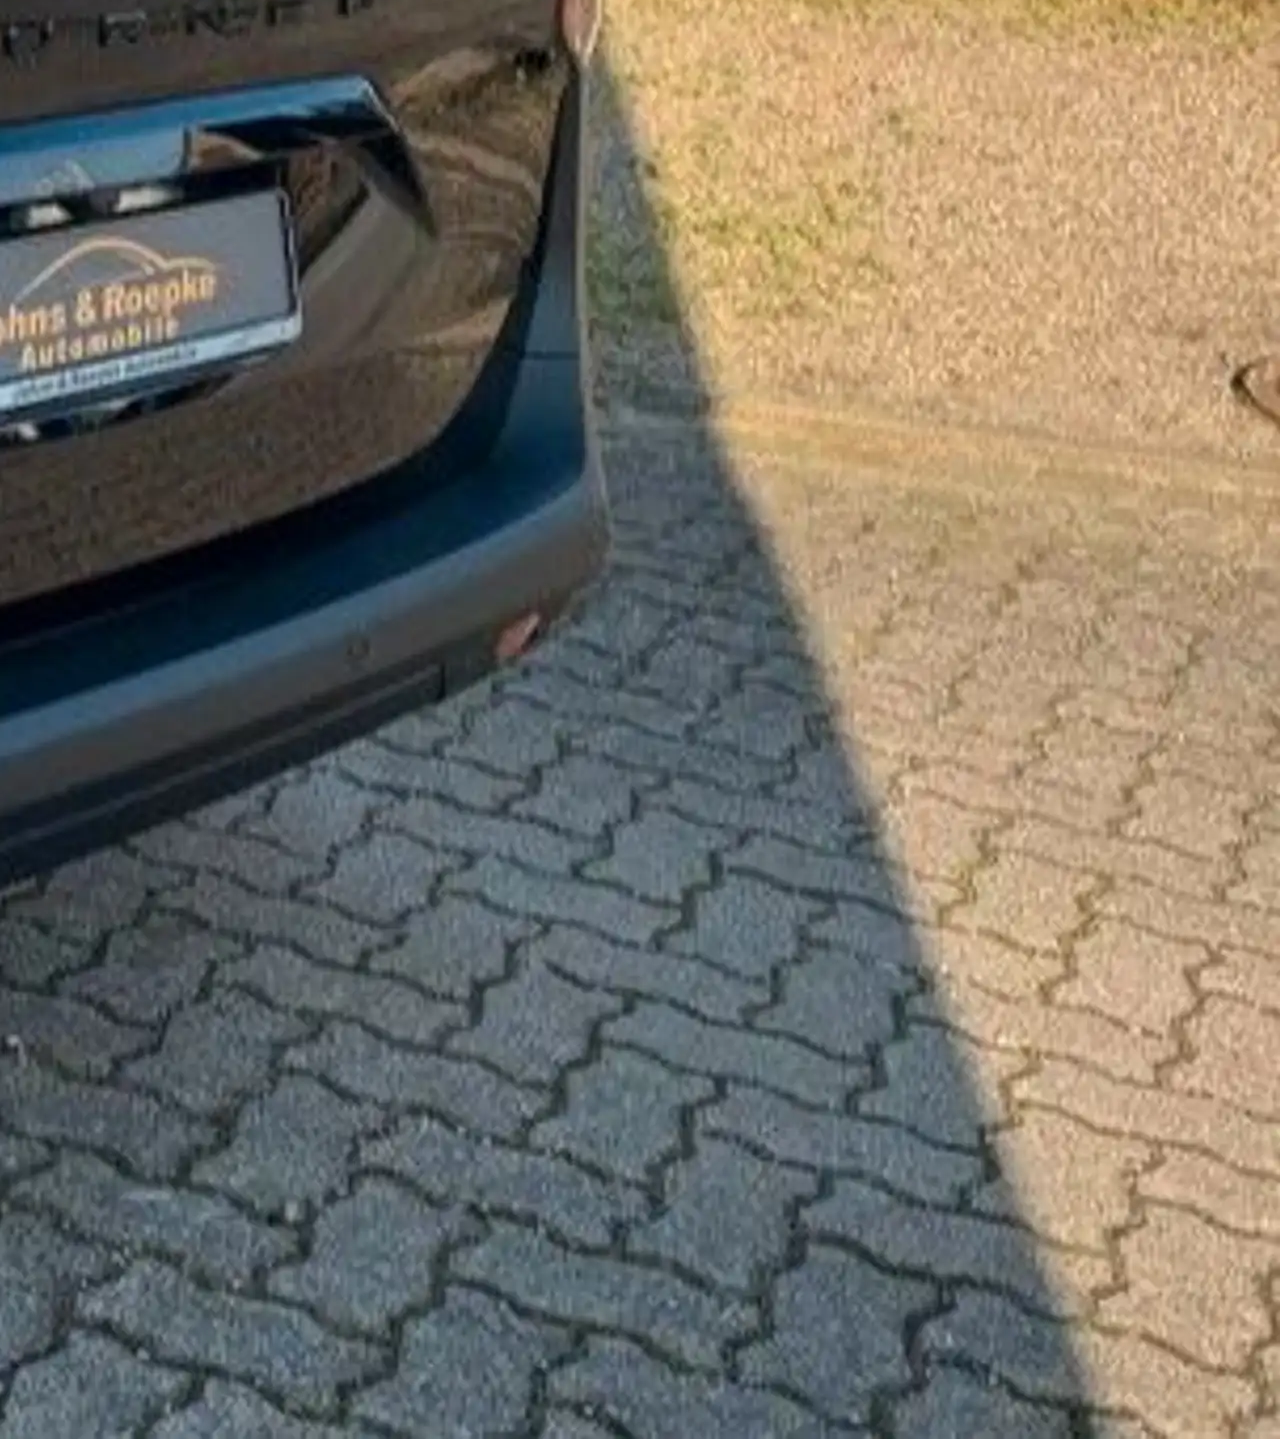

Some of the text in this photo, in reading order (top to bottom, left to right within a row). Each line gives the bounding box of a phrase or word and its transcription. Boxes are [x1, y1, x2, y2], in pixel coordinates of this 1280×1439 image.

[76, 288, 97, 329] &
[103, 267, 218, 322] Roepke
[16, 315, 181, 374] Automobile
